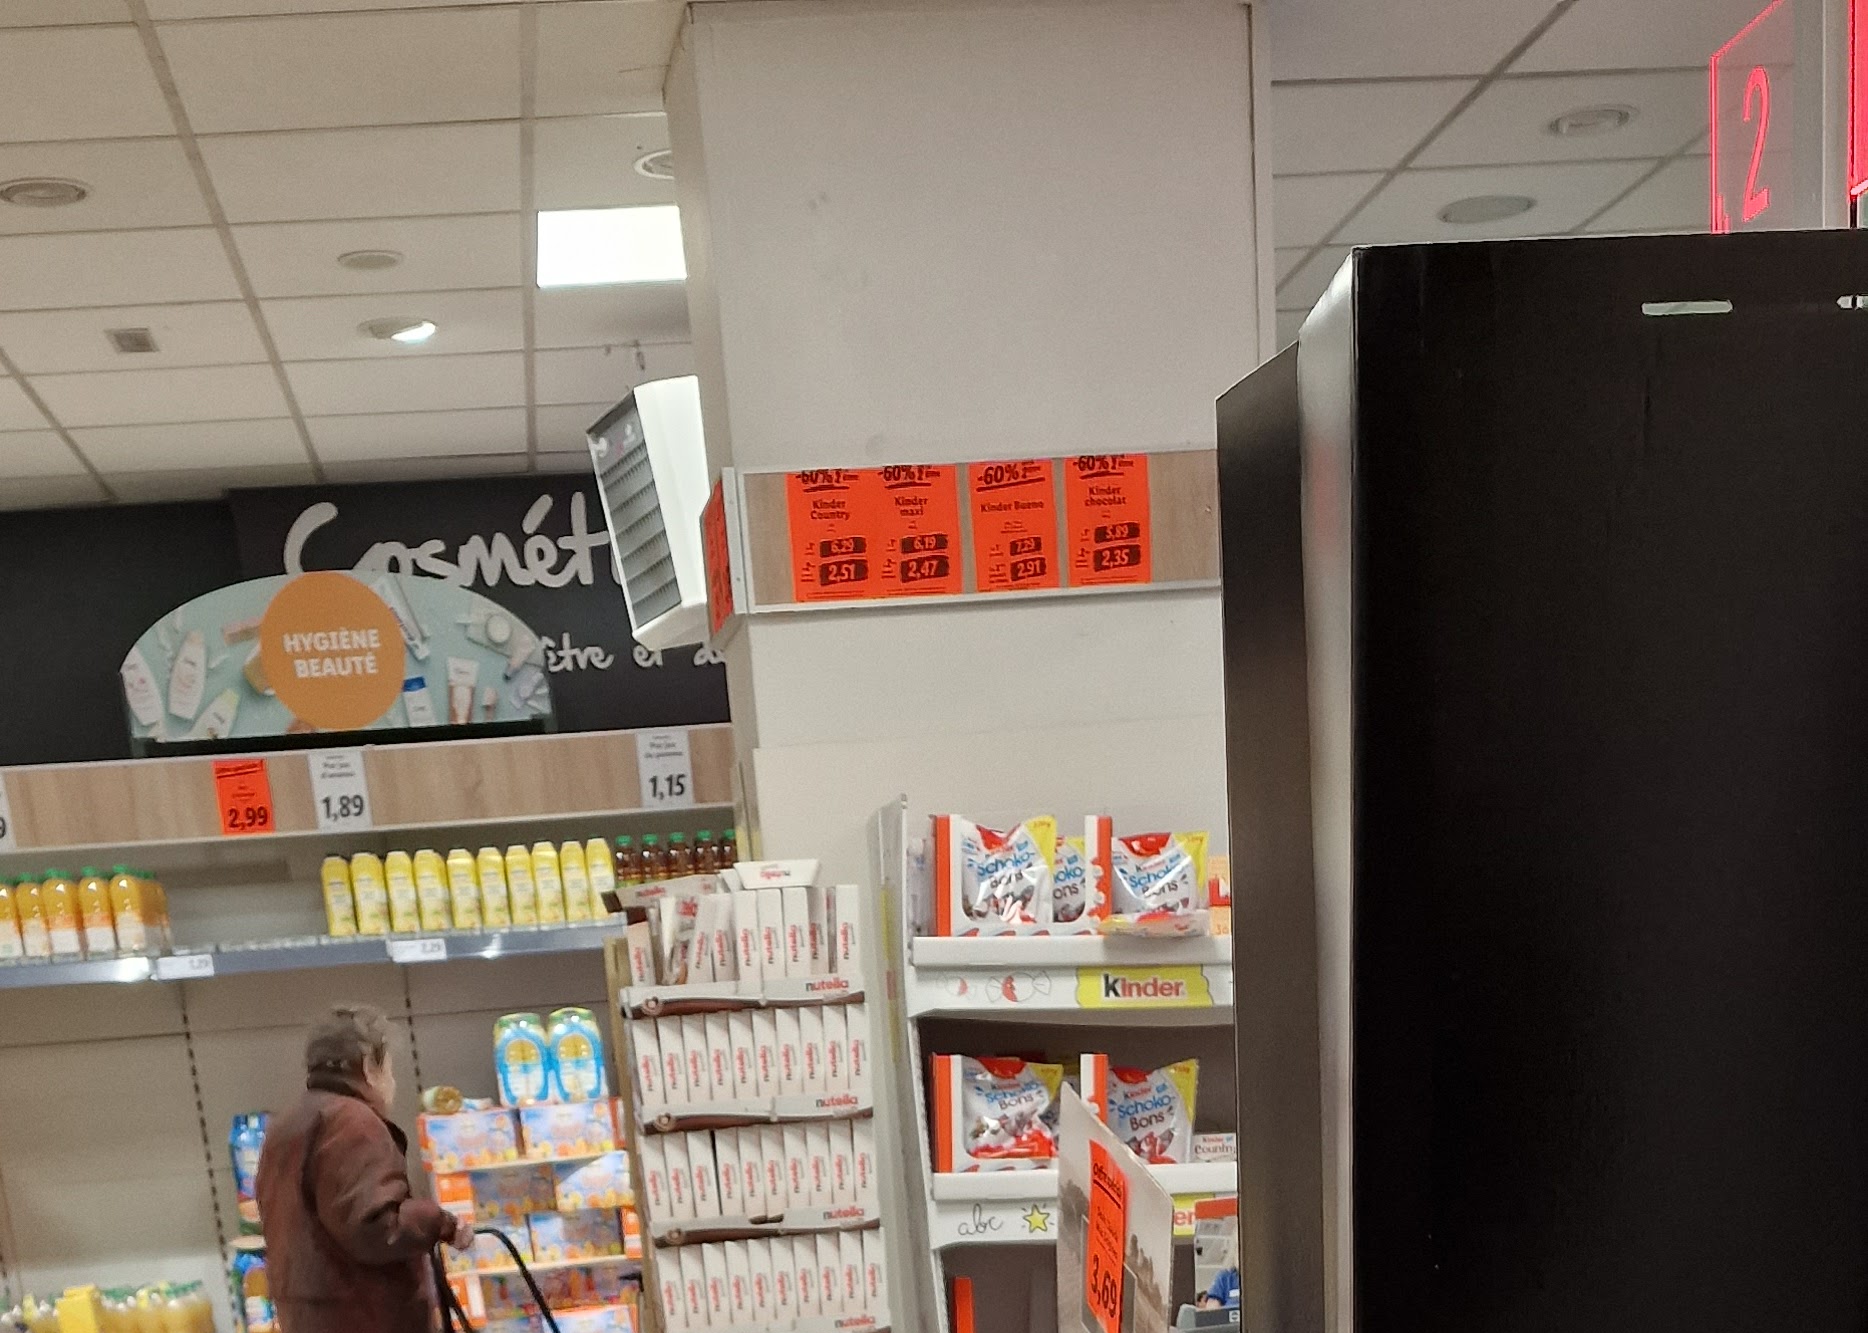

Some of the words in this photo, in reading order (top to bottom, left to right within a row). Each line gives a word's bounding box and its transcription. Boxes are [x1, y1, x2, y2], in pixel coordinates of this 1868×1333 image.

[1742, 65, 1771, 222] 2
[977, 464, 1020, 486] -60%
[283, 491, 620, 588] Cosmét
[1101, 549, 1130, 568] 2,35
[282, 628, 381, 654] HYGIÈNE
[293, 652, 379, 679] BEAUTÉ
[648, 773, 686, 800] 1,15
[228, 806, 268, 831] 2,99
[323, 794, 365, 822] 1,89
[805, 978, 849, 993] nutella
[1103, 973, 1184, 998] Kinder
[1130, 1110, 1165, 1132] Bons
[957, 1203, 1004, 1235] abc
[1091, 1254, 1118, 1319] 3,69
